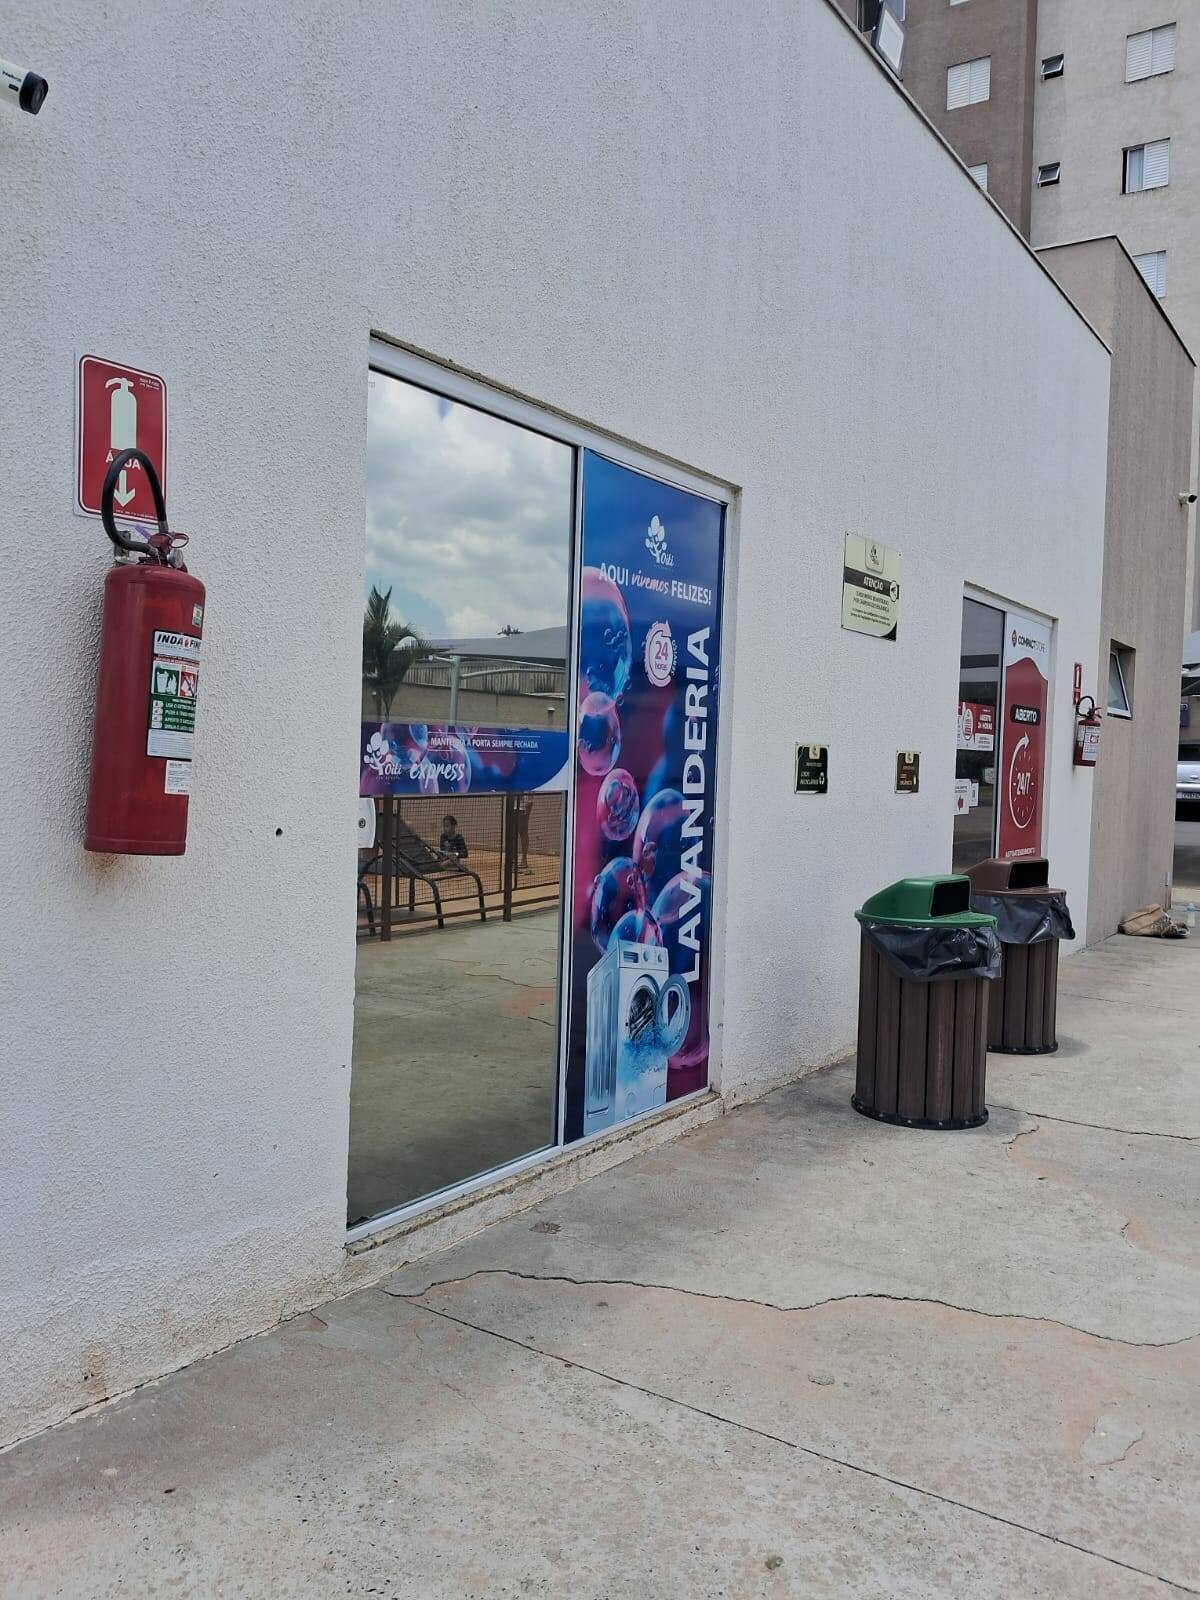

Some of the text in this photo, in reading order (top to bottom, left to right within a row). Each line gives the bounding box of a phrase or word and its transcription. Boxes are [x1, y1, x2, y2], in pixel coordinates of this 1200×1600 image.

[106, 450, 141, 470] ÁUA
[599, 562, 712, 605] AQUI vivemos FELIZES!
[863, 576, 884, 591] ATENÇÃO
[157, 633, 184, 646] INDA
[655, 640, 669, 661] 24
[1015, 707, 1037, 722] ABERTO
[472, 738, 490, 748] PORTA
[492, 739, 514, 749] SEMPRE
[514, 740, 538, 750] FECHADA
[409, 762, 465, 789] express
[1016, 772, 1031, 796] 24/7
[678, 626, 711, 985] LAVANDERIA
